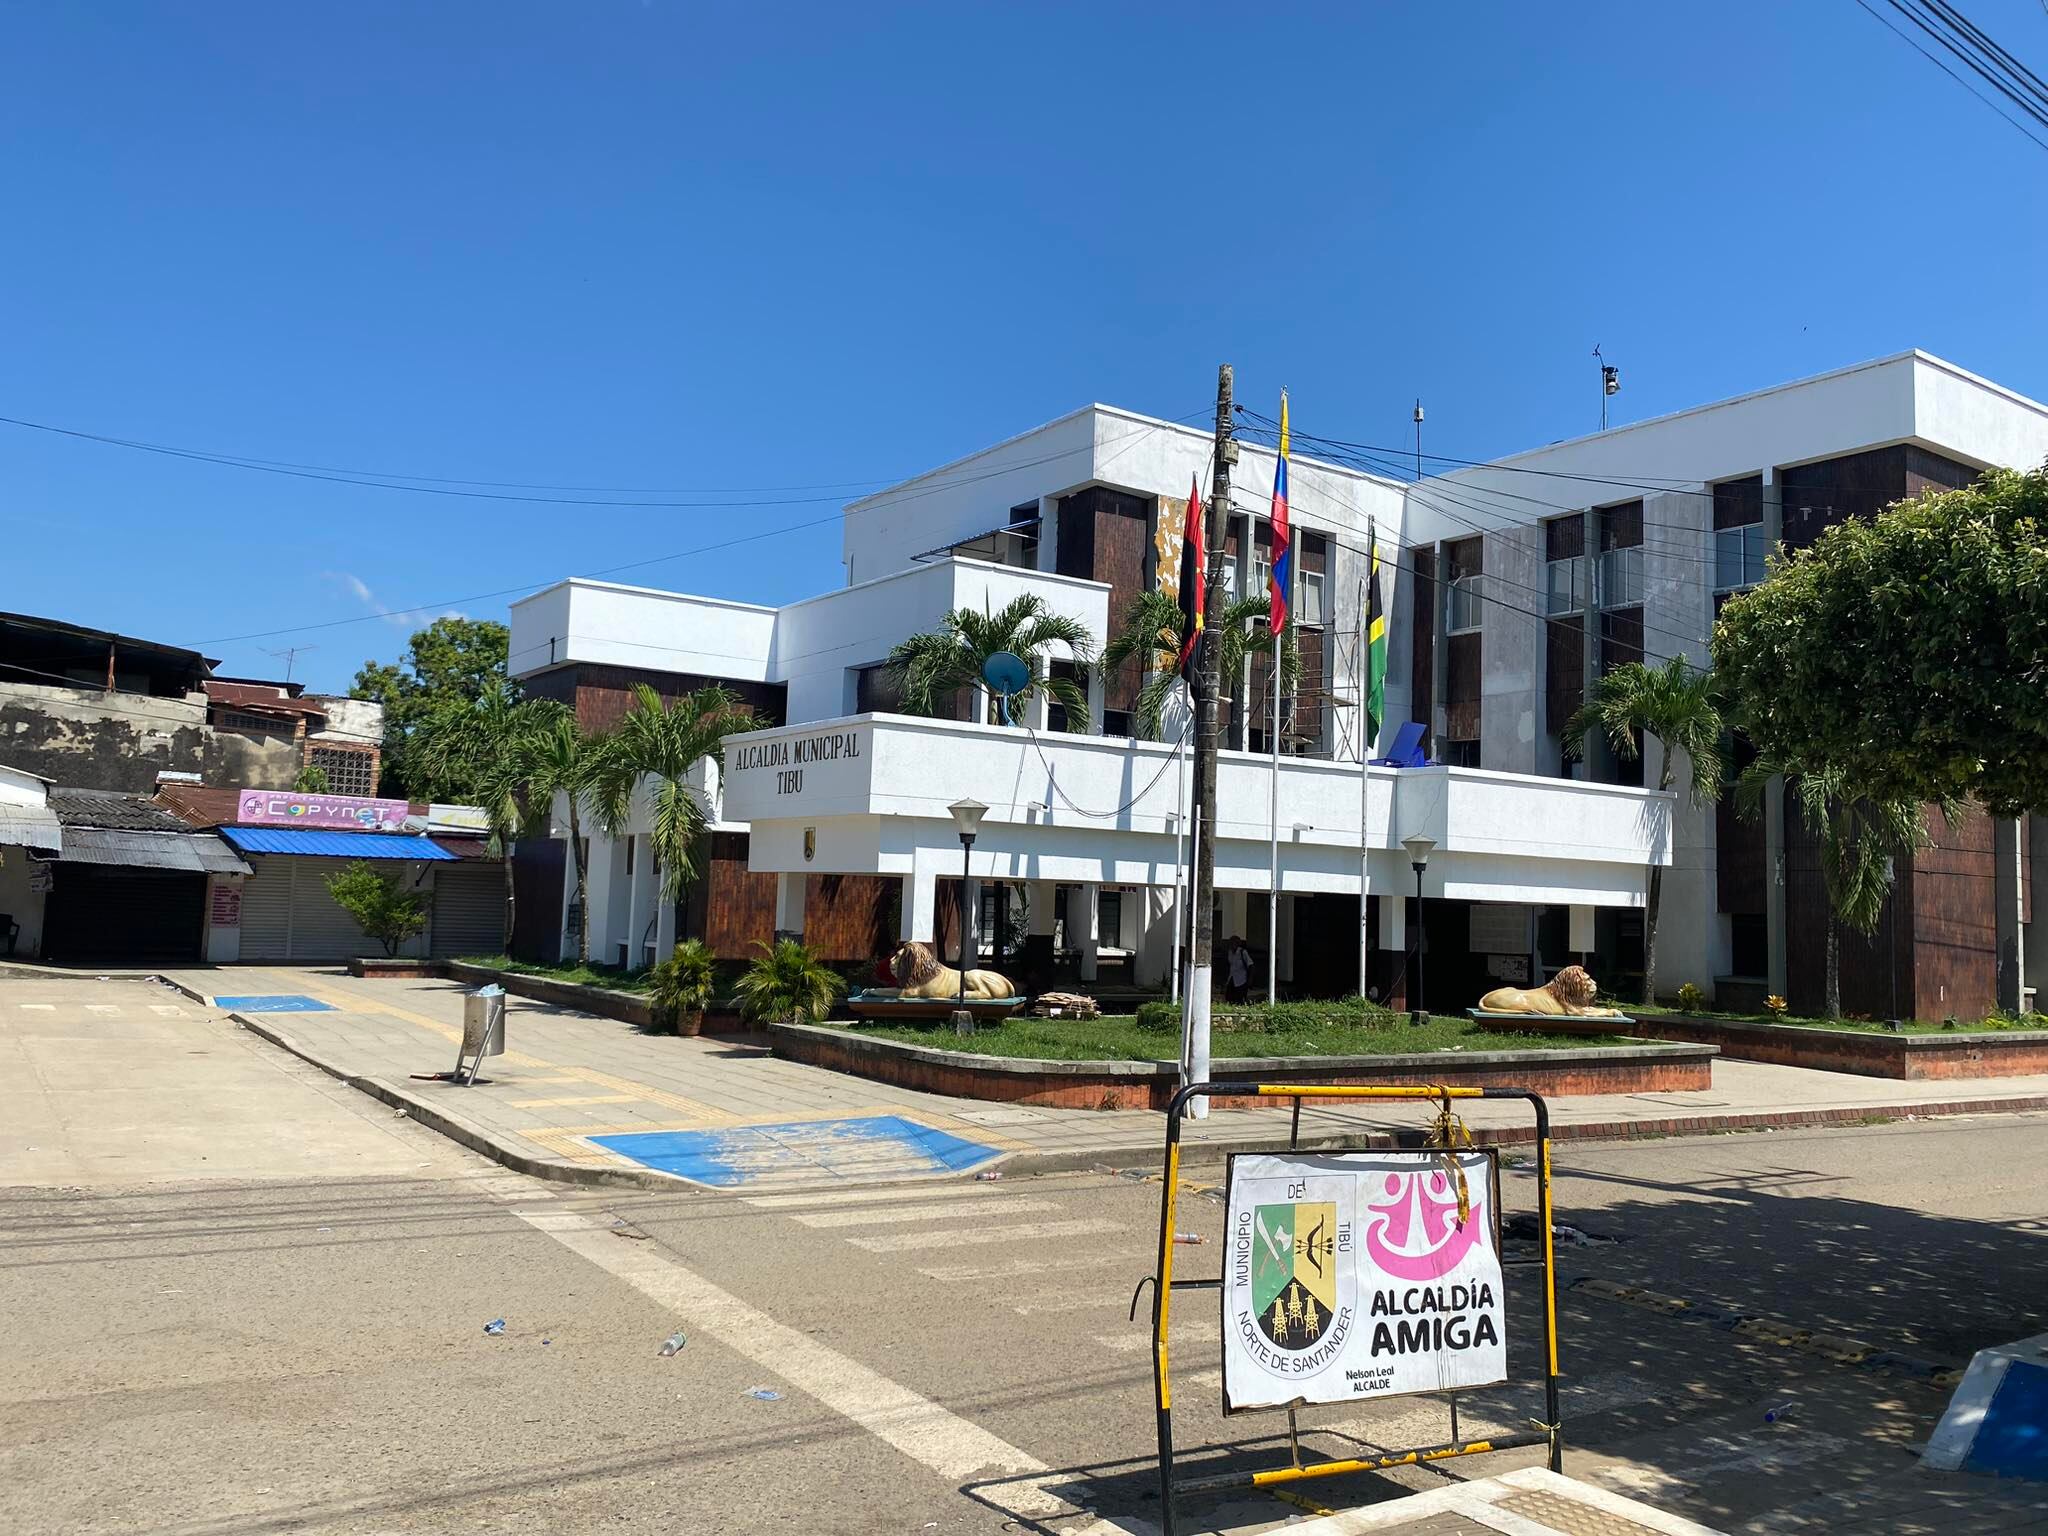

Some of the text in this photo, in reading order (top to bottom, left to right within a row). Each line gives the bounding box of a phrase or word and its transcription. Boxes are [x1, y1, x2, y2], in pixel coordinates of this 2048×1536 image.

[735, 733, 860, 771] ALCALDIA MUNICIPAL
[777, 770, 803, 795] TIBU
[1287, 1183, 1303, 1199] DE
[1236, 1211, 1251, 1287] MUNICIPIO
[1338, 1221, 1353, 1252] TIBÚ
[1370, 1278, 1495, 1317] ALCALDÍA
[1238, 1306, 1353, 1373] NORTE DE SANTANDER
[1370, 1313, 1499, 1358] AMIGA
[1345, 1365, 1395, 1381] Nelson Leal
[1353, 1378, 1391, 1393] ALCALDE
